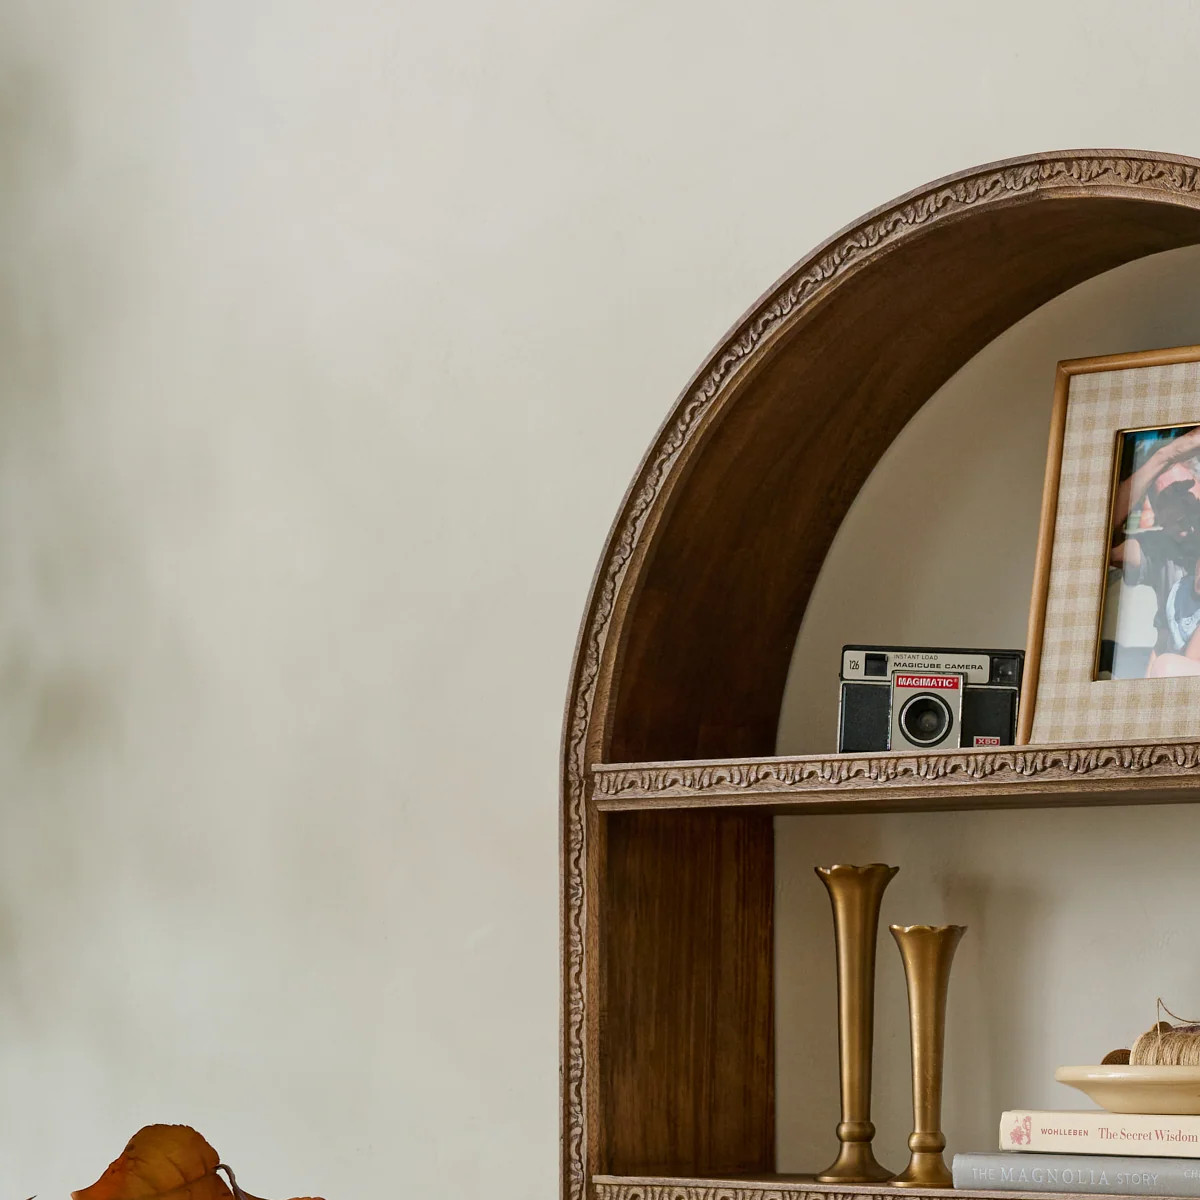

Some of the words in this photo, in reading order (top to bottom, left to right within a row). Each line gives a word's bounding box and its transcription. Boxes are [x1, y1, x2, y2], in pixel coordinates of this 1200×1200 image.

[849, 660, 860, 670] 126
[1040, 1128, 1089, 1136] WOHLLEBEN
[1098, 1128, 1118, 1140] The
[1120, 1128, 1152, 1141] Secret
[1154, 1129, 1198, 1143] Wisdom
[972, 1168, 996, 1180] THE
[1000, 1167, 1110, 1185] MAGNOLIA
[1117, 1172, 1158, 1185] STORY
